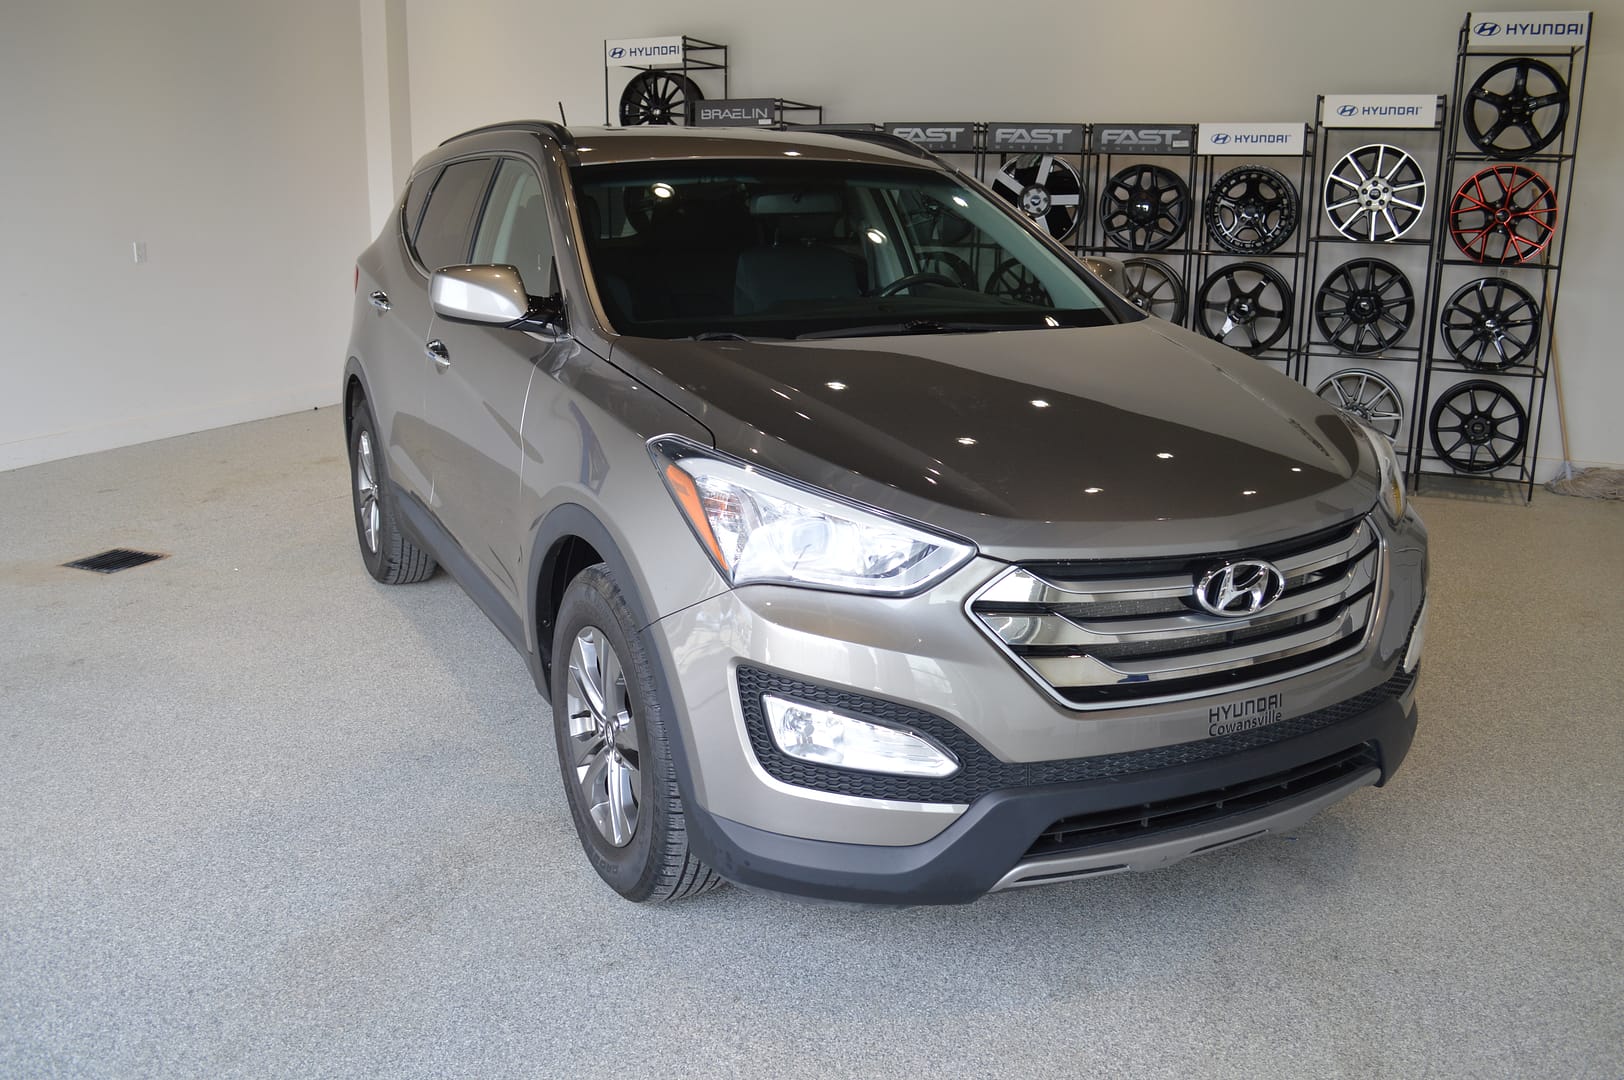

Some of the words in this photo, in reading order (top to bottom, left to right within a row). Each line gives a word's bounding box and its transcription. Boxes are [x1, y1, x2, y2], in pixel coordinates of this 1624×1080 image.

[1505, 23, 1583, 35] HYUNDAI
[629, 45, 680, 57] HYUNDAI
[701, 107, 768, 120] BRAELIN
[1361, 106, 1419, 116] HYUNDAI
[892, 127, 965, 142] FAST
[995, 128, 1073, 144] FAST
[1101, 129, 1182, 145] FAST
[1234, 134, 1289, 143] HYUNDAI
[1208, 693, 1282, 723] HYUNDAI
[1208, 709, 1282, 737] Cowansville
